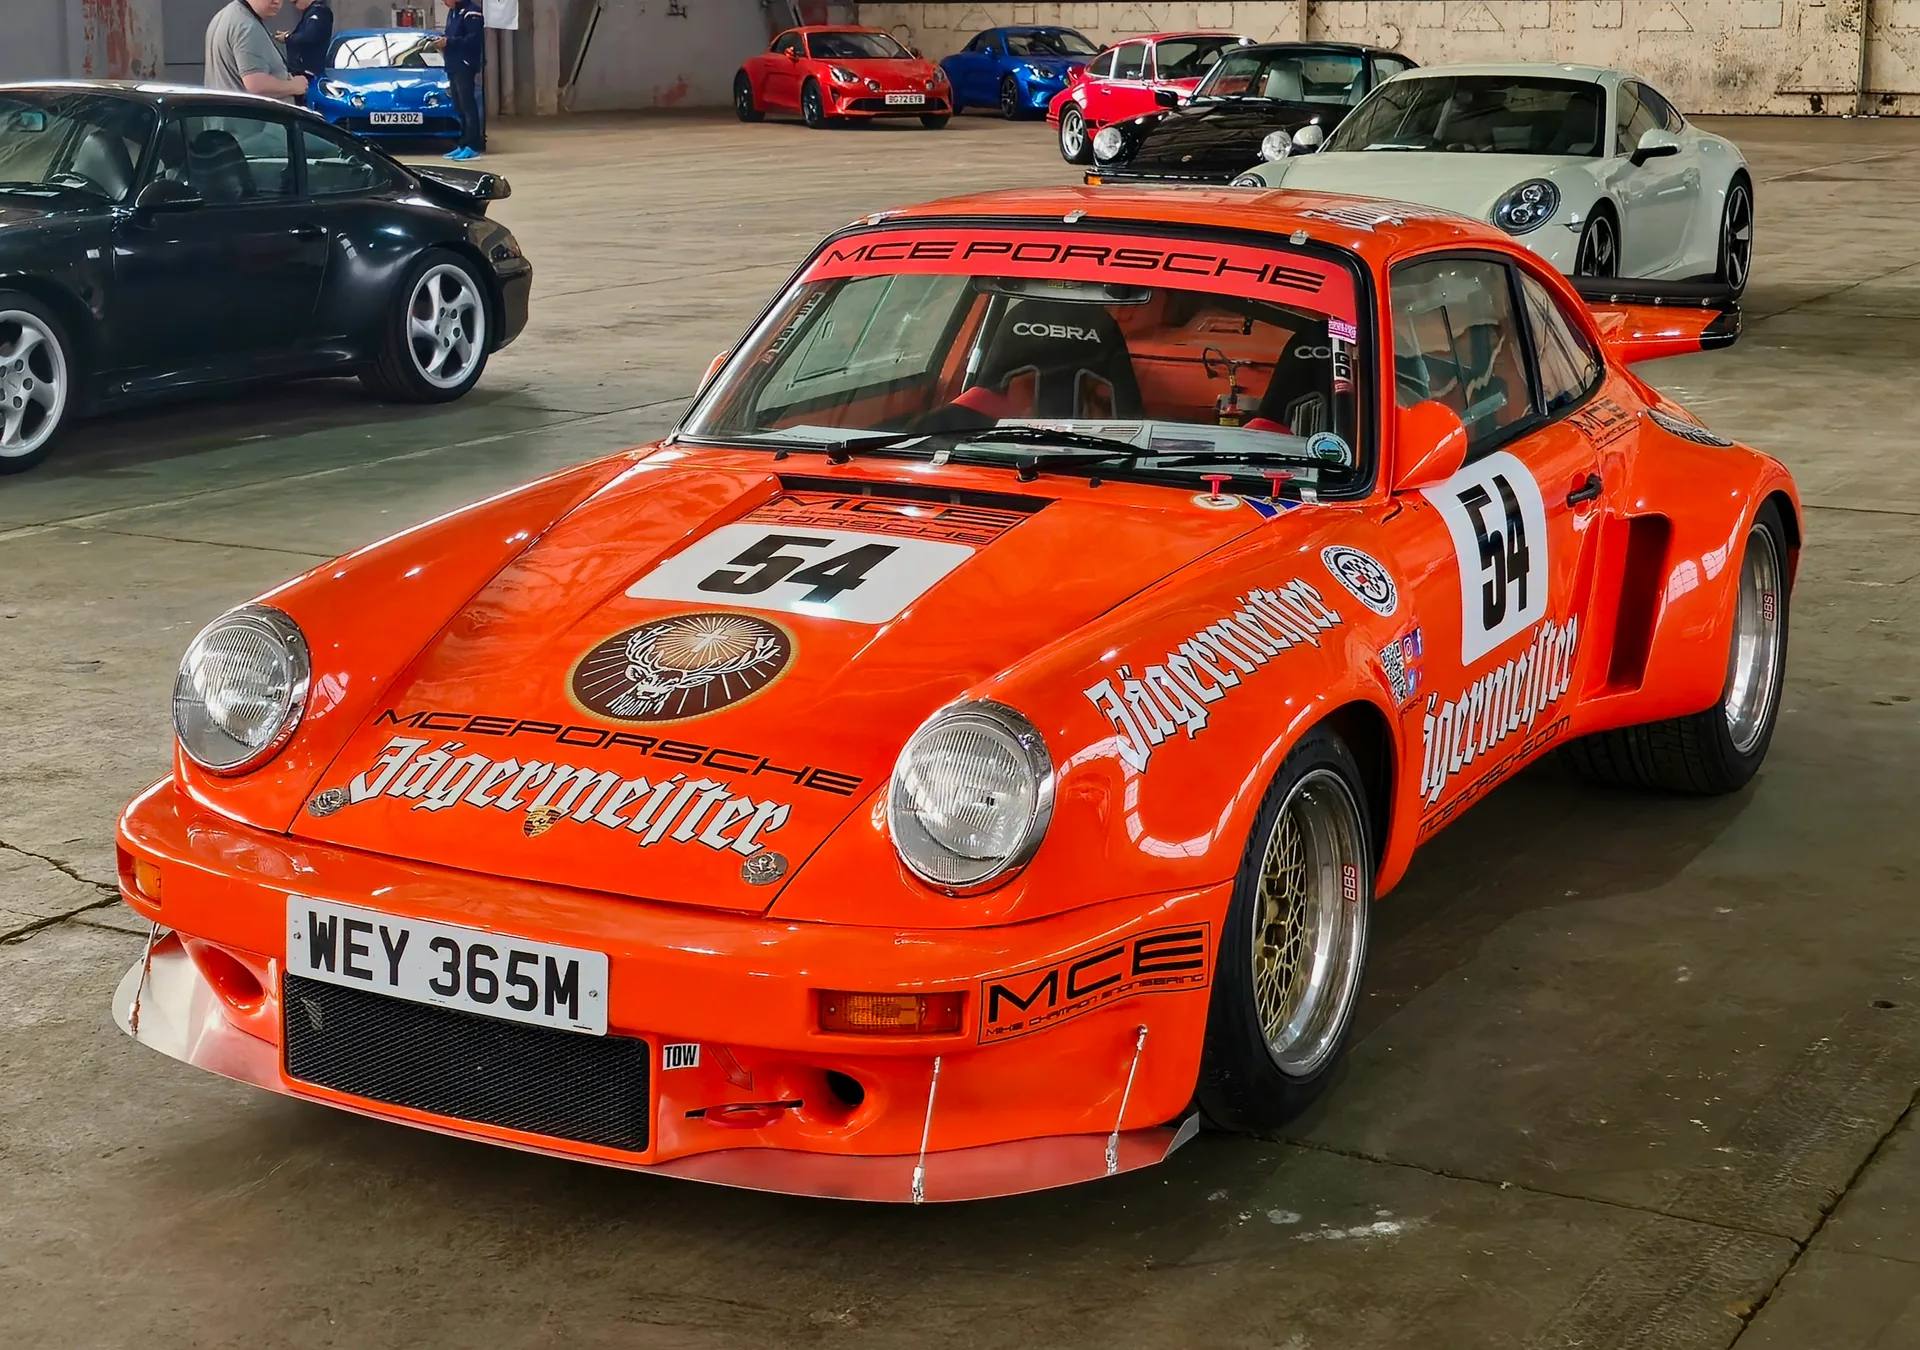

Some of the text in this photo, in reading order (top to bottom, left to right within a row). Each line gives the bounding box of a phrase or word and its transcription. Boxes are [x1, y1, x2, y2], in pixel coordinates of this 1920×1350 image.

[823, 241, 1328, 294] MCE PORSCHE
[1012, 322, 1102, 344] COBRA
[745, 513, 995, 543] PORSCHE
[766, 494, 1021, 529] MCE
[697, 534, 901, 604] 54
[1456, 474, 1530, 631] 54
[1763, 593, 1774, 621] BBS
[1082, 577, 1344, 774] Jägermeister
[1419, 612, 1579, 810] ägermeister
[371, 707, 865, 797] MCEPORSCHE
[347, 734, 793, 855] Jägermeister
[1343, 865, 1356, 901] BBS
[308, 910, 580, 1021] WEY 365M
[988, 929, 1204, 1024] MCE
[664, 1044, 698, 1069] TOW
